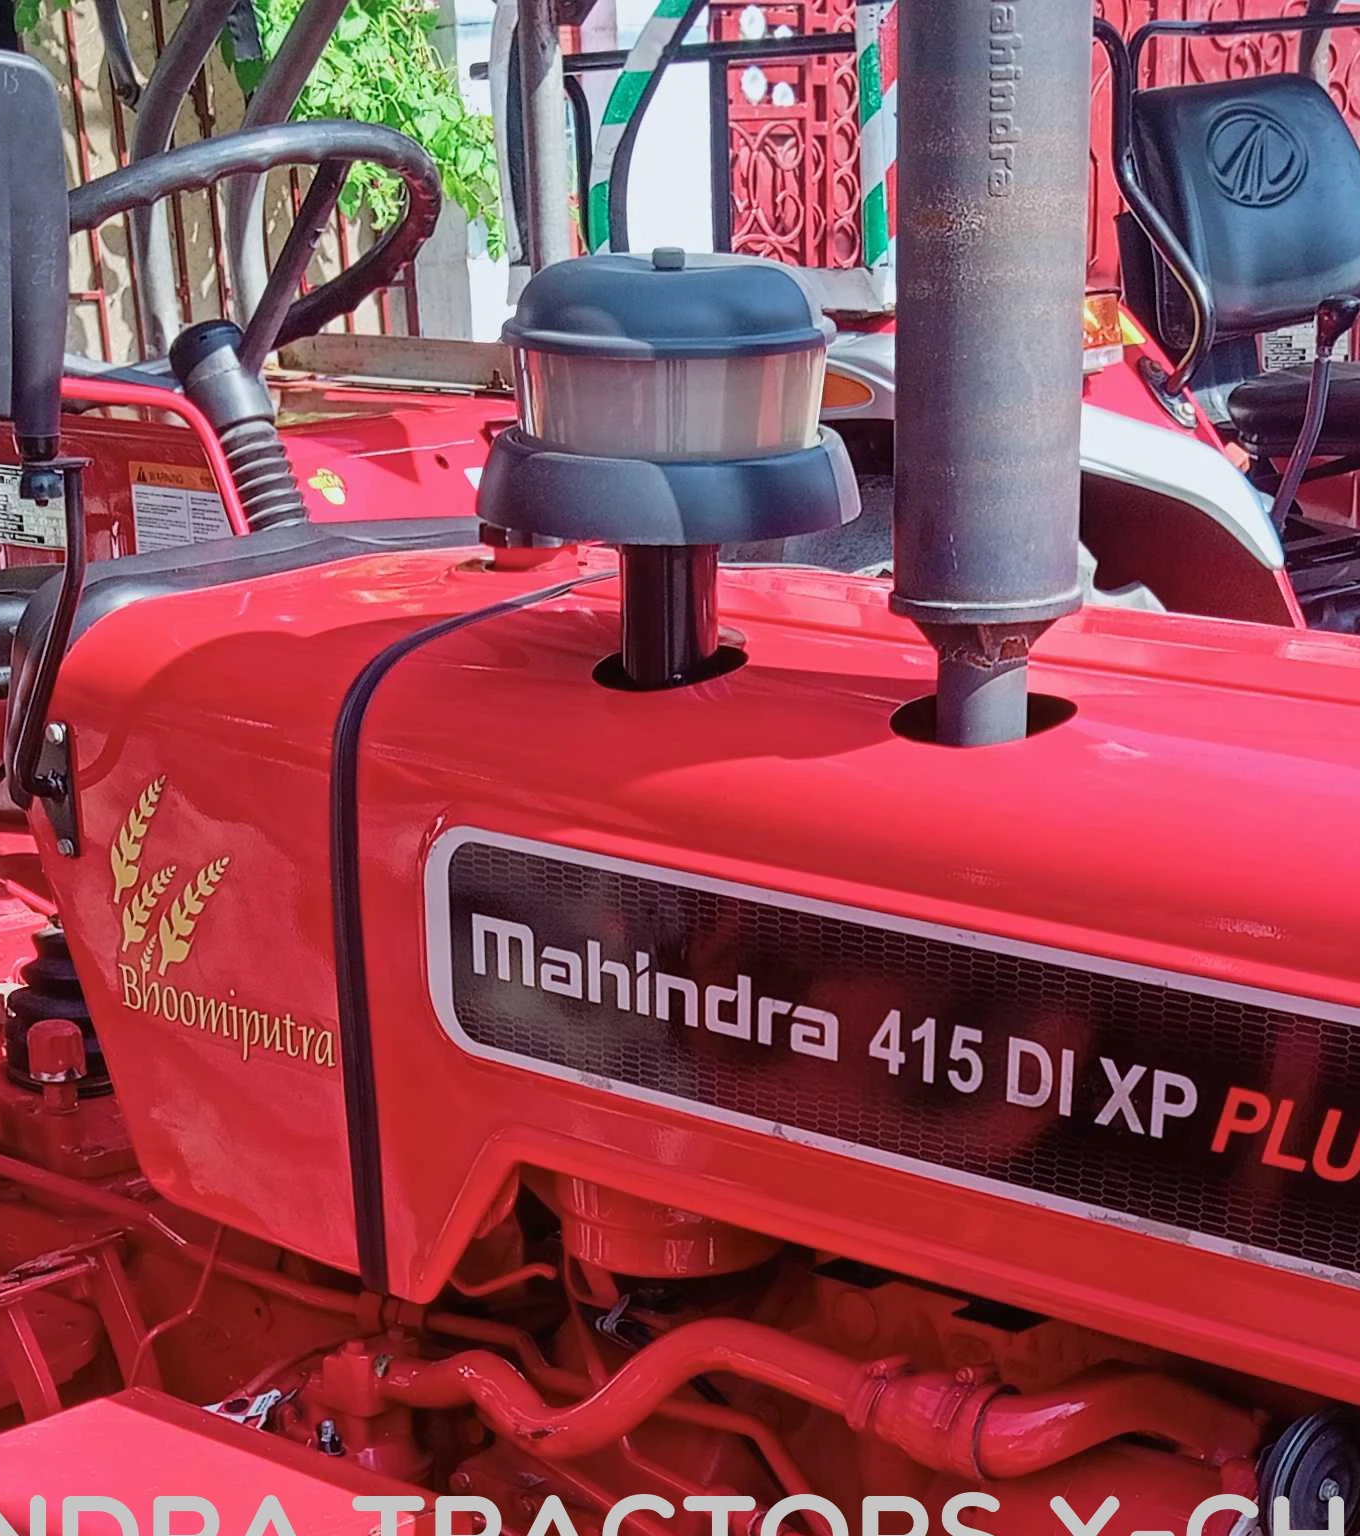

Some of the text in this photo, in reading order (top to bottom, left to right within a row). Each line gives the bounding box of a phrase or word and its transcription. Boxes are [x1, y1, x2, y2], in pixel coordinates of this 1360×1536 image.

[988, 0, 1024, 198] ahindra
[118, 962, 337, 1068] Bhoomiputra
[471, 912, 839, 1063] Mahindra
[868, 1008, 984, 1094] 415
[1005, 1035, 1075, 1117] DI
[1094, 1056, 1199, 1139] XP
